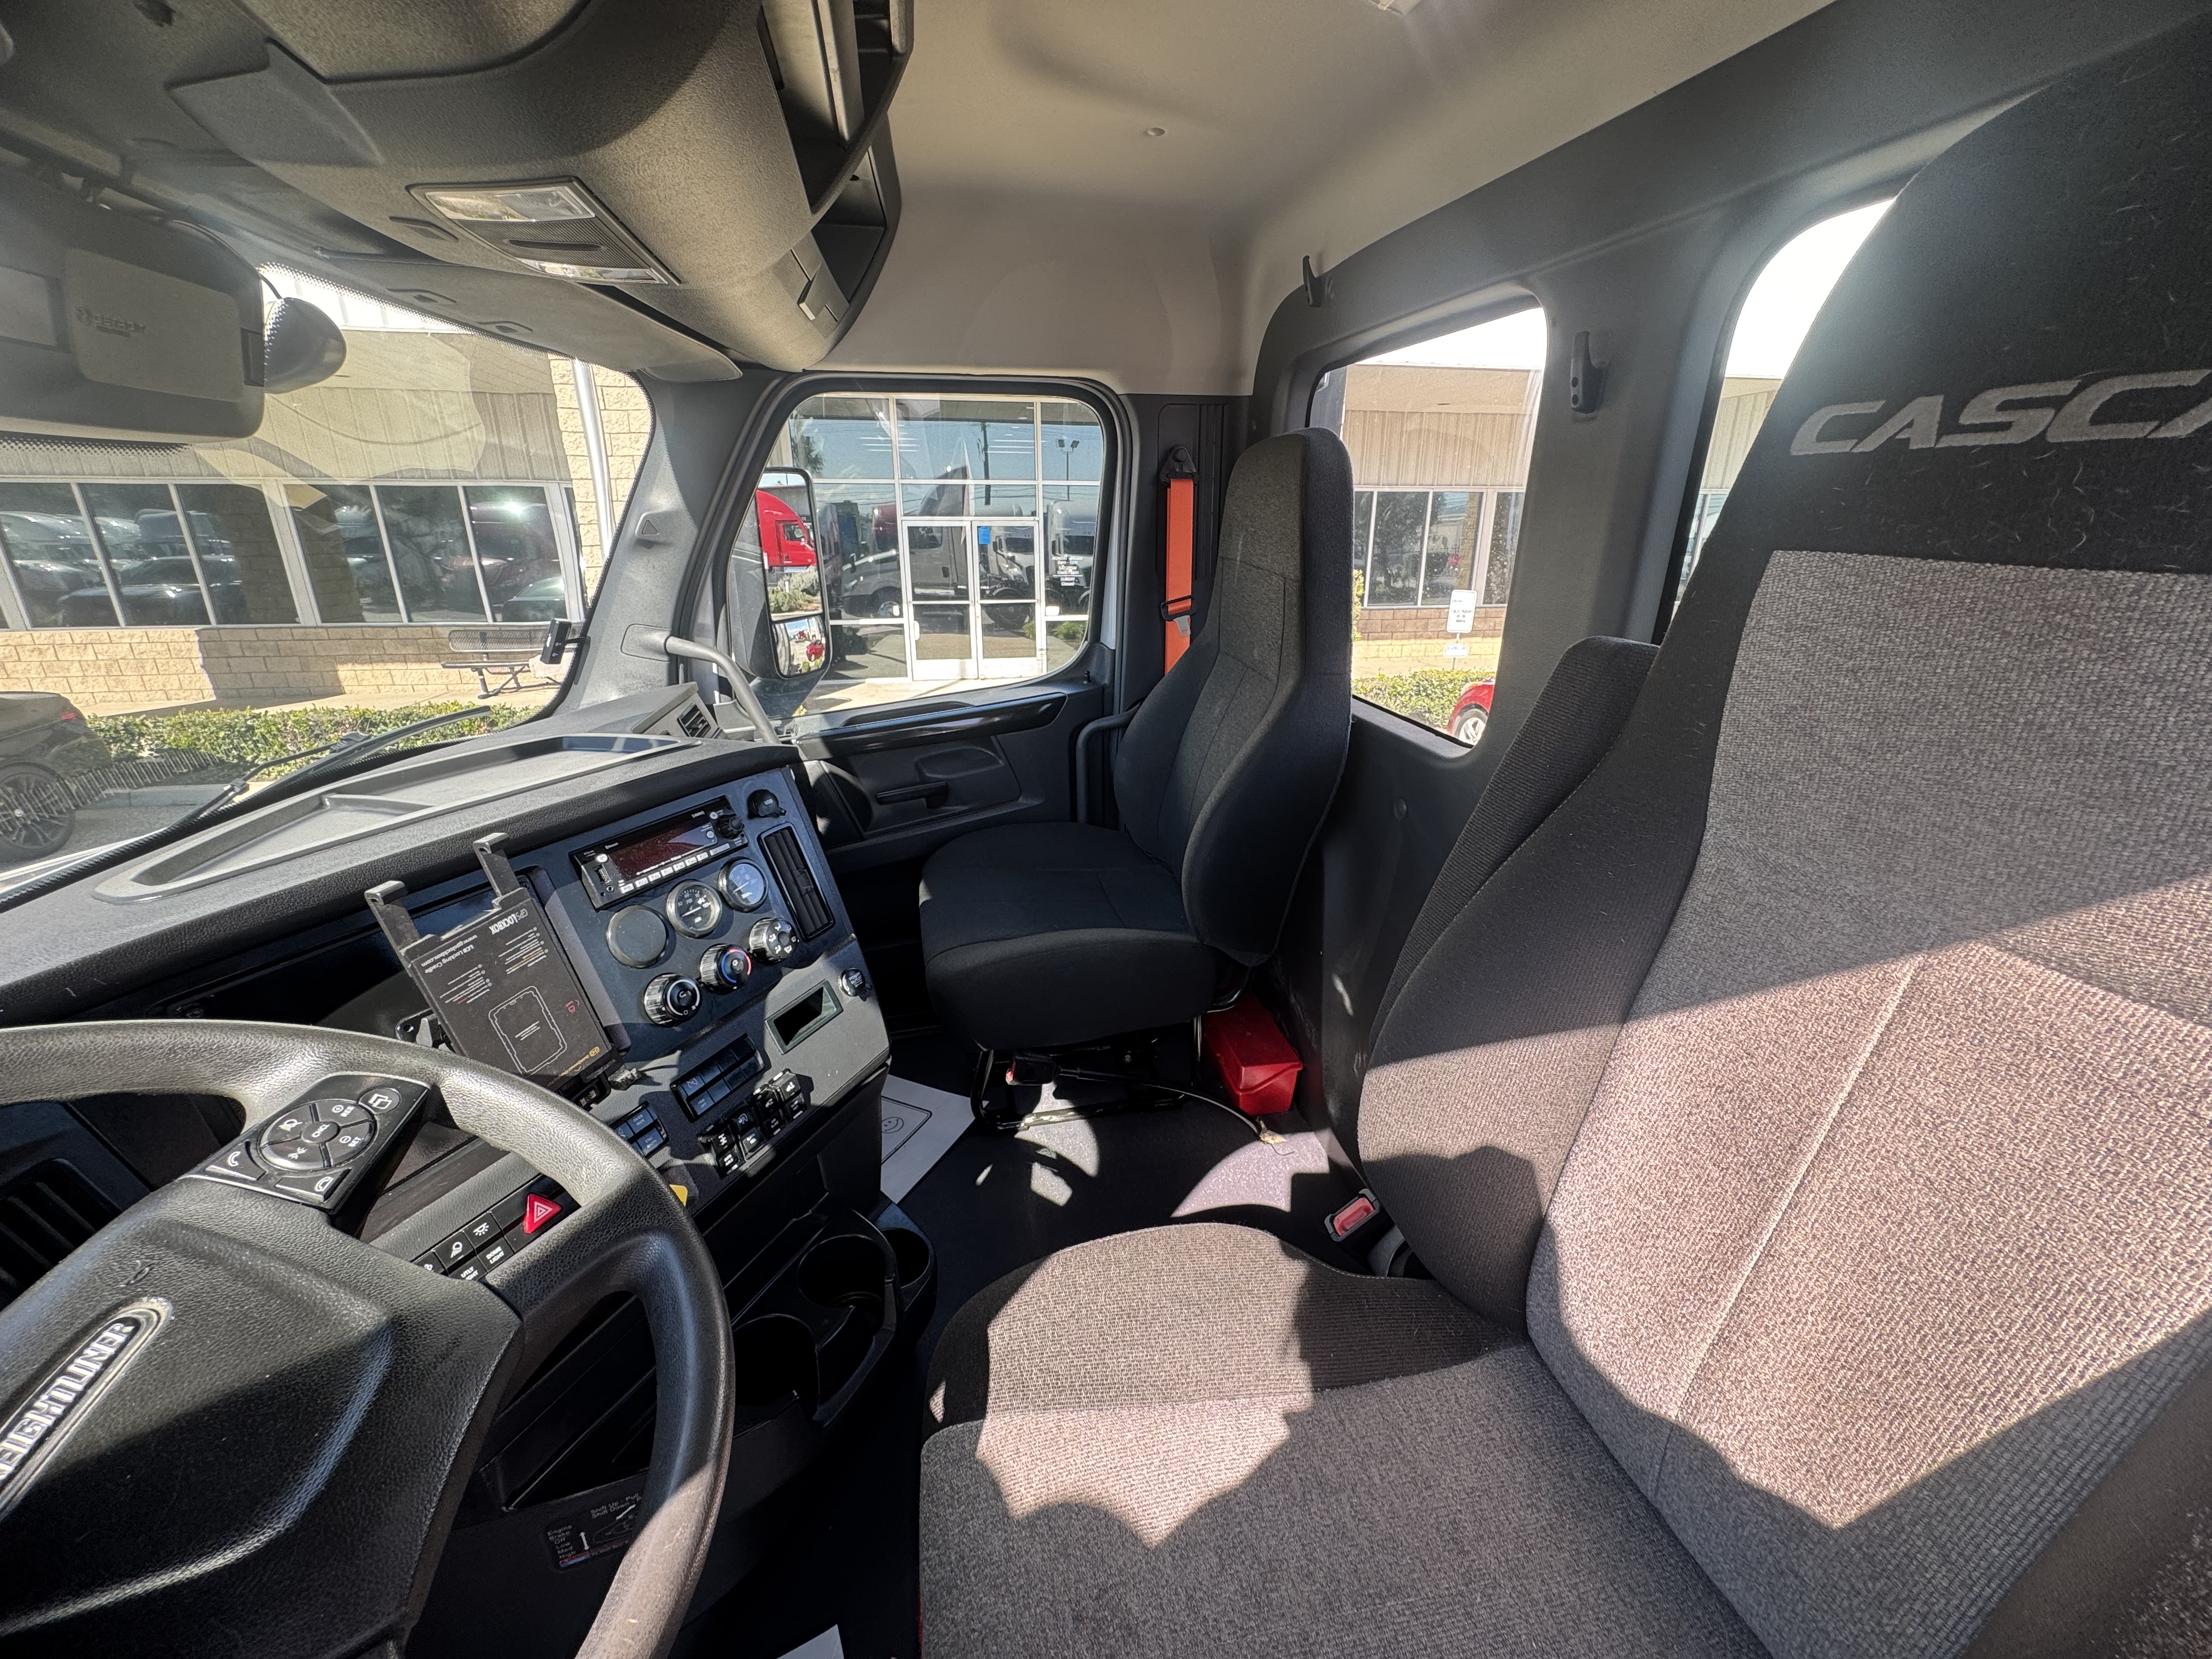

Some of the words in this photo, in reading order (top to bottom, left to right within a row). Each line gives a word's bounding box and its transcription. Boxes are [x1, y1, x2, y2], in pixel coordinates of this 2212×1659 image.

[442, 950, 463, 964] Locking
[425, 962, 443, 974] Cradle
[340, 1106, 354, 1118] RES
[312, 1124, 330, 1138] CNCL
[348, 1137, 362, 1147] SET
[486, 1246, 503, 1260] DOME
[489, 1250, 505, 1265] LIGHT
[460, 1266, 474, 1278] UTLY
[0, 1323, 135, 1480] EIGHTLINER
[548, 1525, 572, 1536] Engine
